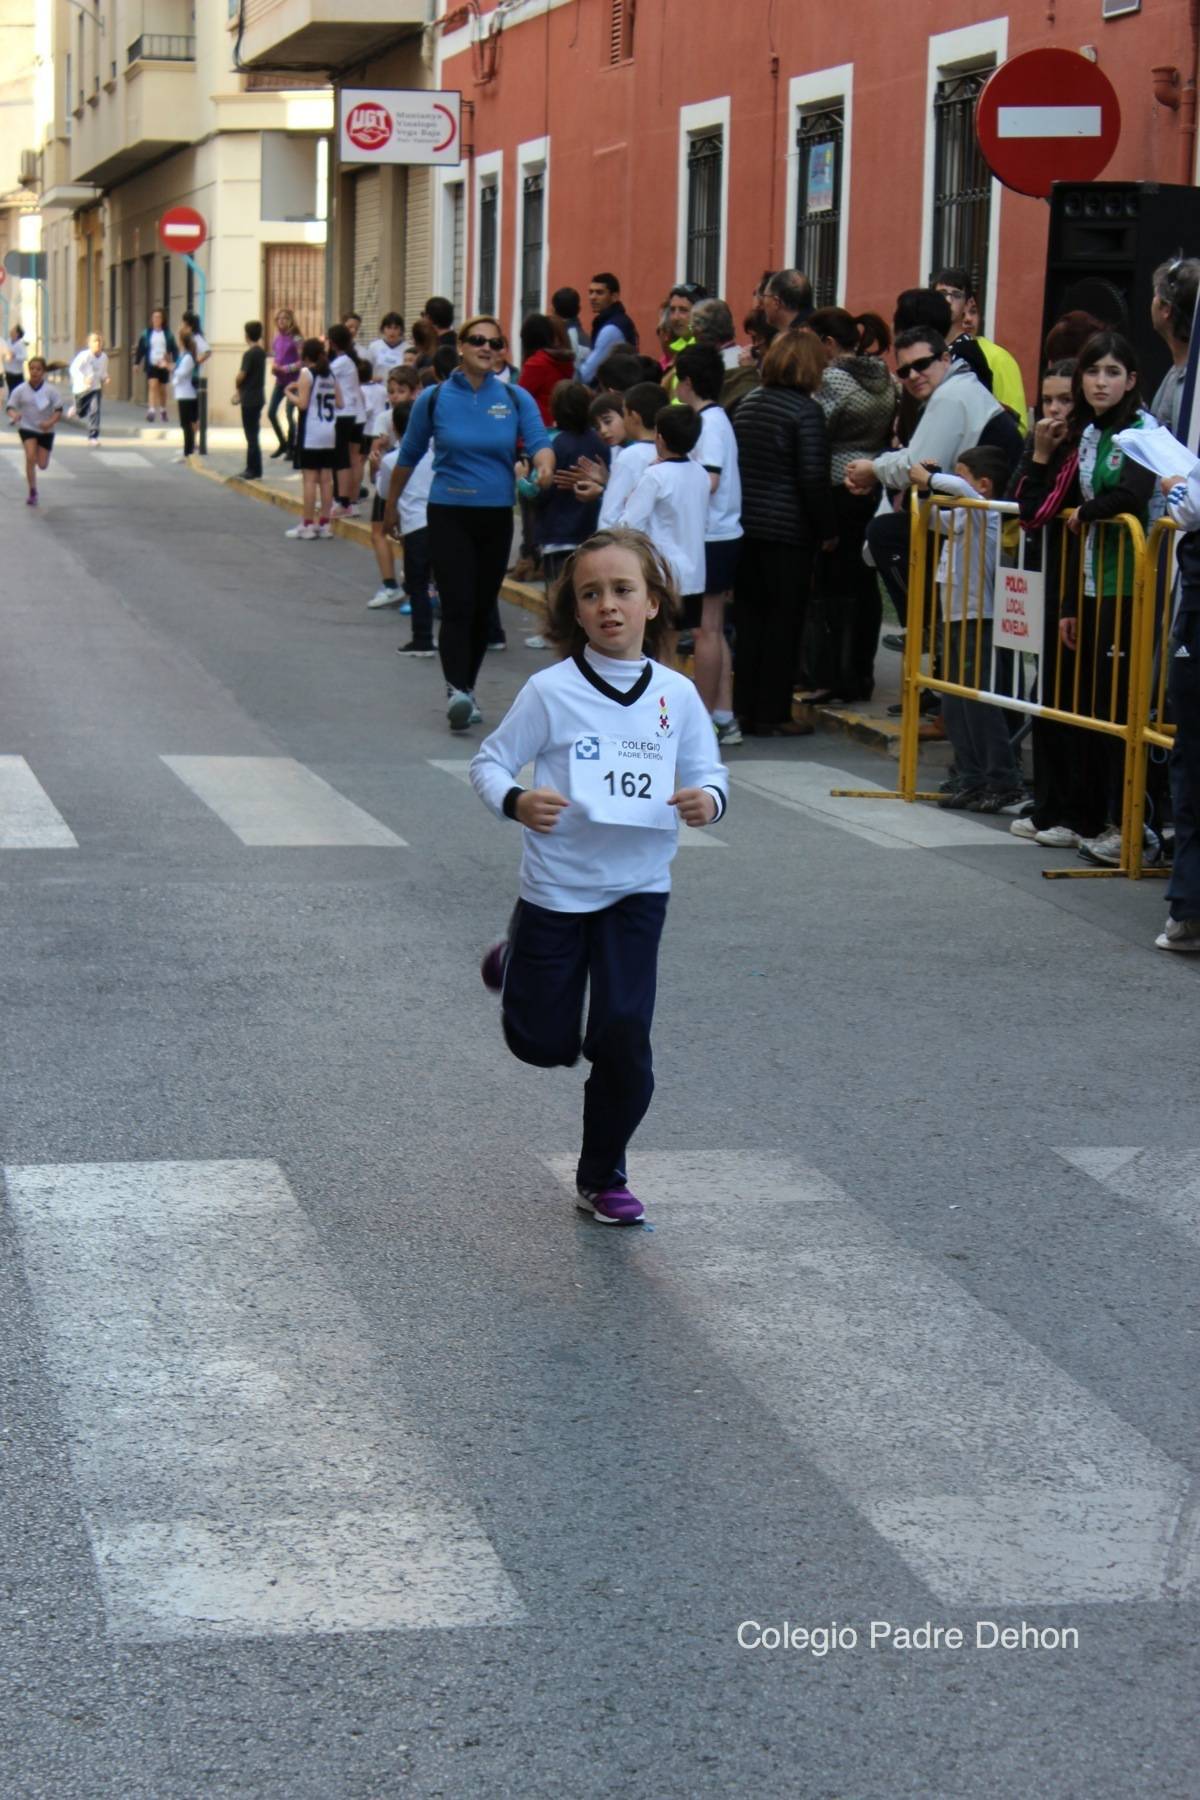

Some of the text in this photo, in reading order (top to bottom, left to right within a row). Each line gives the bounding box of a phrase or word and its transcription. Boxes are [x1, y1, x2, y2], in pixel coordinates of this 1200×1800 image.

[351, 109, 387, 128] UGT
[316, 393, 336, 422] 15
[1006, 597, 1026, 616] LOCAL
[1001, 618, 1030, 637] NOVELDA
[618, 751, 641, 760] PADRE
[621, 740, 661, 752] COLEGIO
[604, 770, 652, 799] 162
